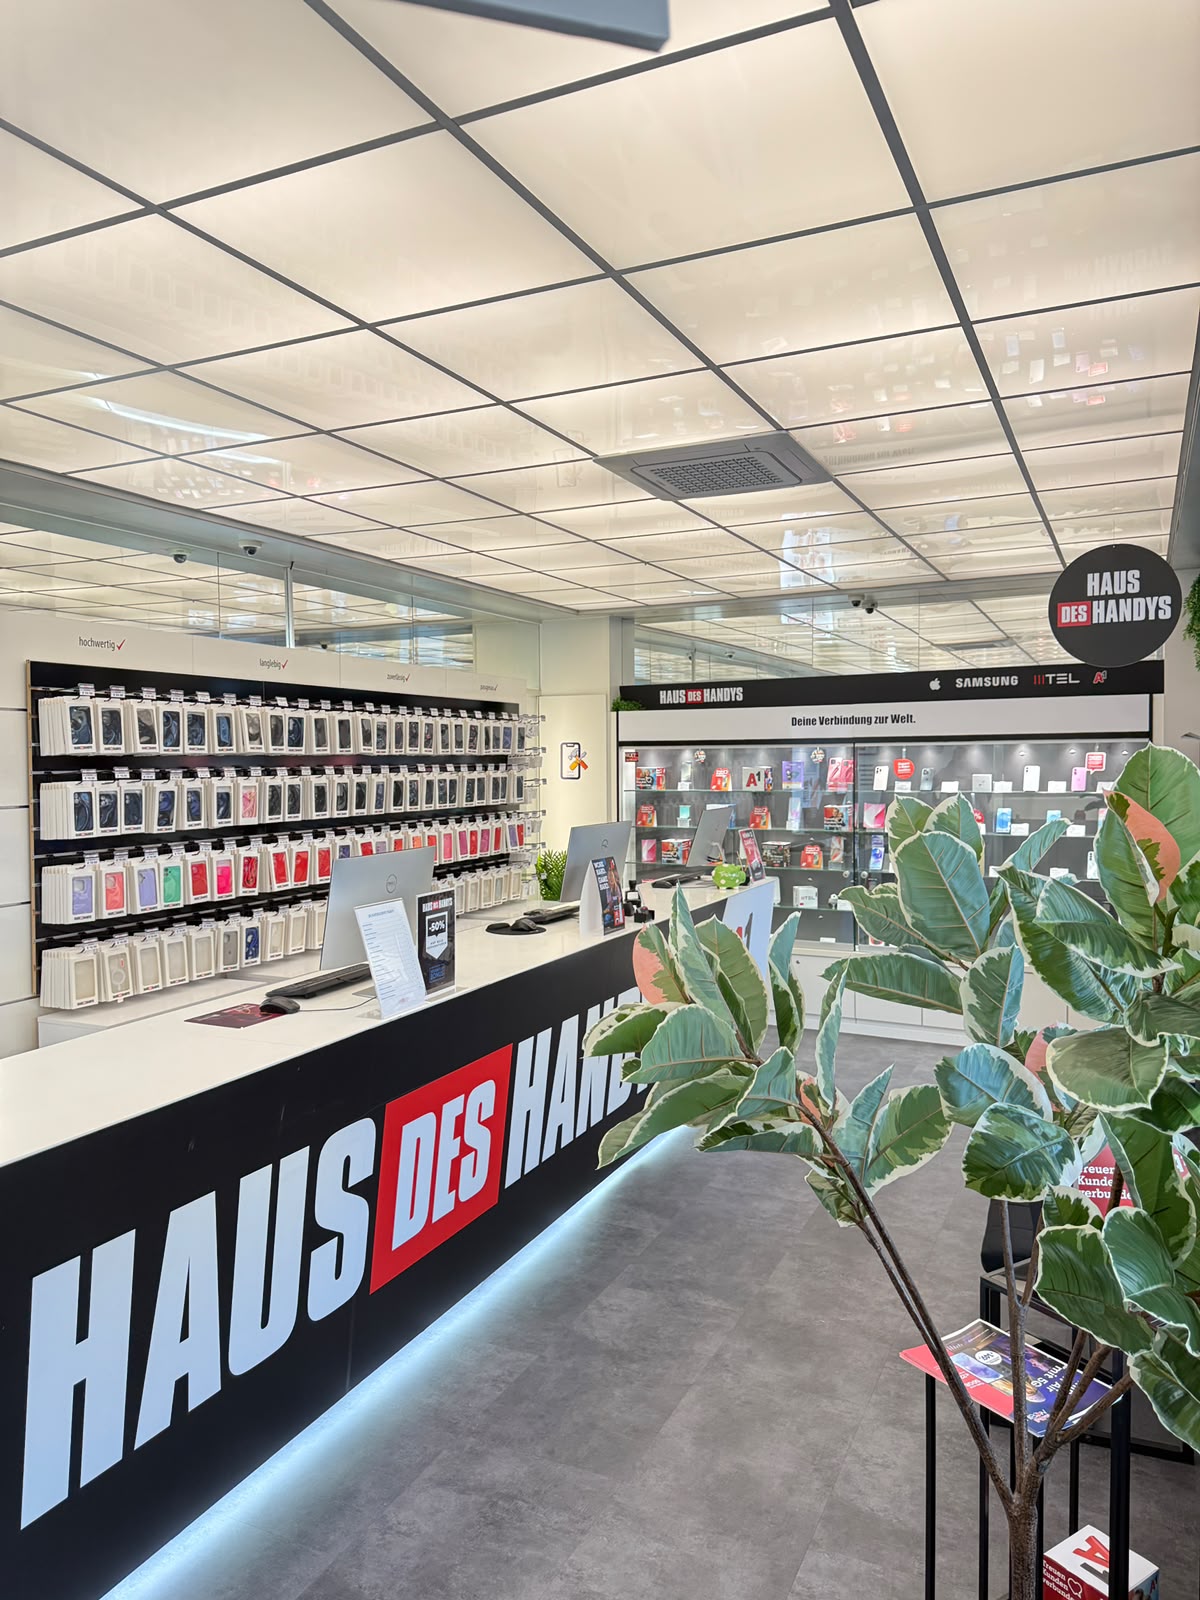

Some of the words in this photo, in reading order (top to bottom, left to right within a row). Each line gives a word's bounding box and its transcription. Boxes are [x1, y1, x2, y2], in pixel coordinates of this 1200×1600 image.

[1087, 569, 1140, 597] HAUS
[1061, 604, 1088, 624] DES
[1092, 595, 1172, 624] HANDYS
[78, 636, 115, 651] hochwertig
[259, 658, 281, 669] langlebig
[955, 675, 1019, 688] SAMSUNG
[1092, 670, 1107, 684] A1
[660, 689, 686, 704] HAUS
[687, 691, 702, 702] DES
[703, 687, 744, 703] HANDYS
[791, 716, 817, 727] Deine
[818, 714, 873, 726] Verbindung
[874, 715, 889, 724] zur
[890, 713, 916, 724] Welt.
[745, 770, 761, 787] A1
[1083, 1166, 1116, 1174] reuen
[1078, 1176, 1113, 1186] Kunde
[20, 1118, 377, 1530] HAUS
[391, 1080, 497, 1252] DES
[504, 986, 648, 1190] HAND
[1072, 1535, 1109, 1585] A1
